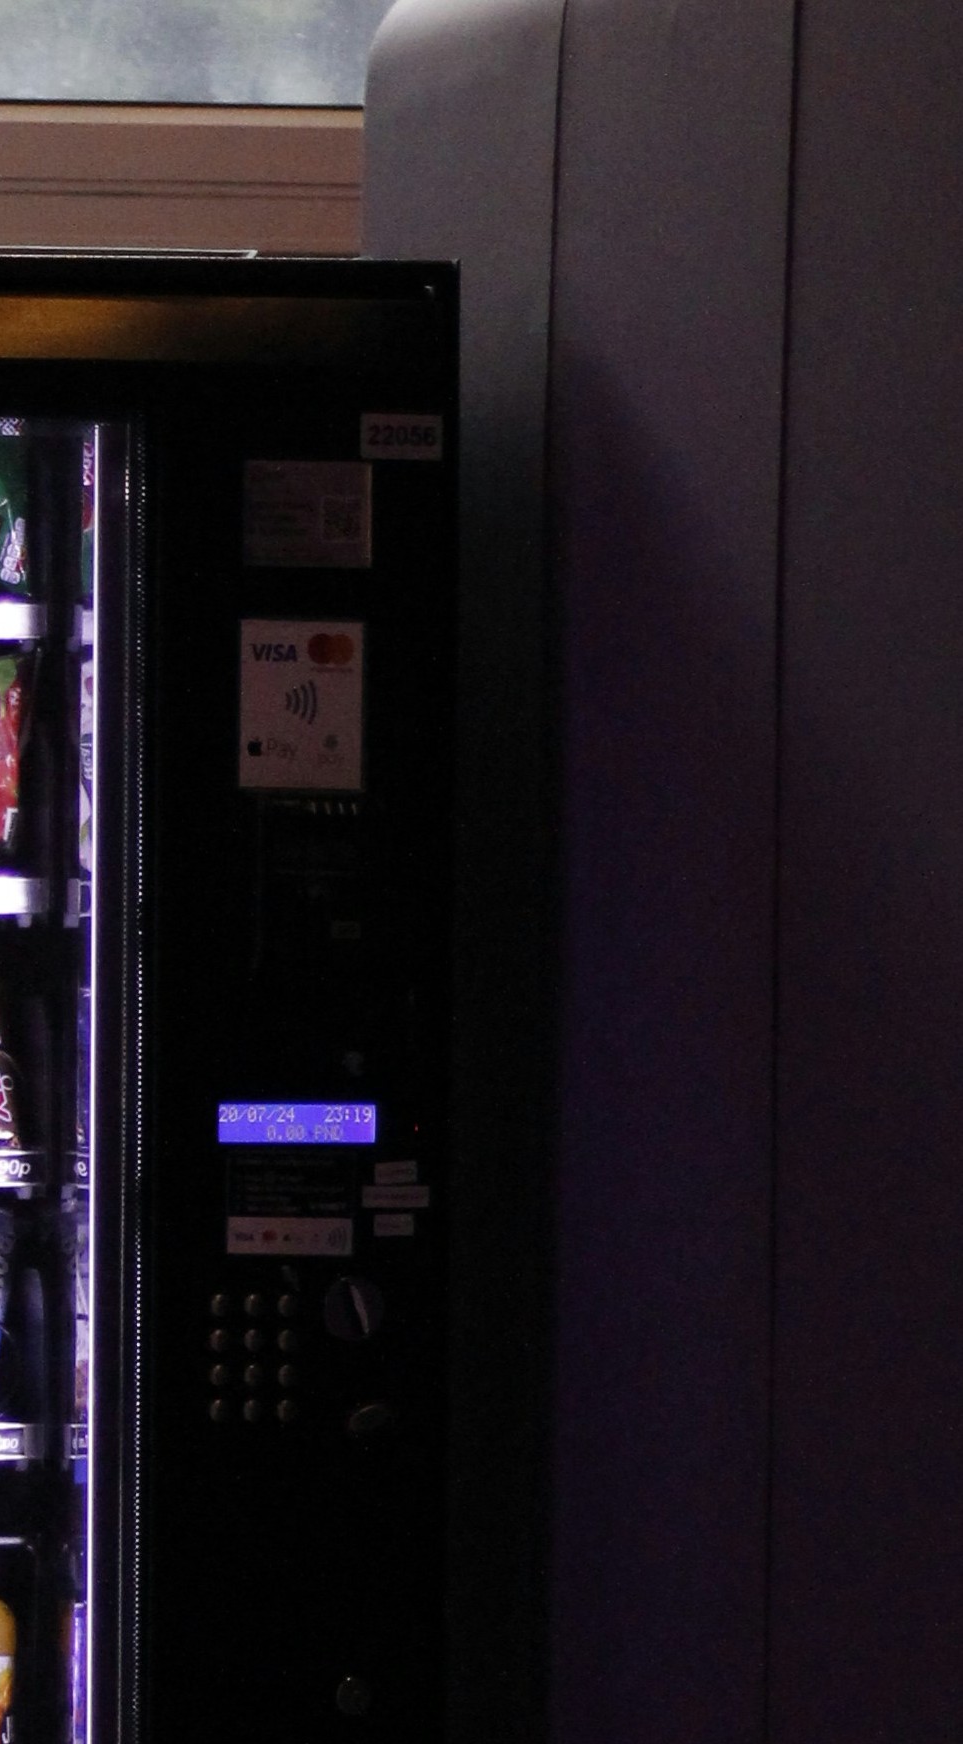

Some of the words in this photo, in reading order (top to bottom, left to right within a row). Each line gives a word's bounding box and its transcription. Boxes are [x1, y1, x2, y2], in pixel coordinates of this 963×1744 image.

[366, 425, 436, 446] 22056
[252, 643, 299, 662] VISA
[218, 1106, 296, 1123] 20/07/24
[324, 1106, 373, 1123] 23:19
[266, 1124, 305, 1141] 0.00
